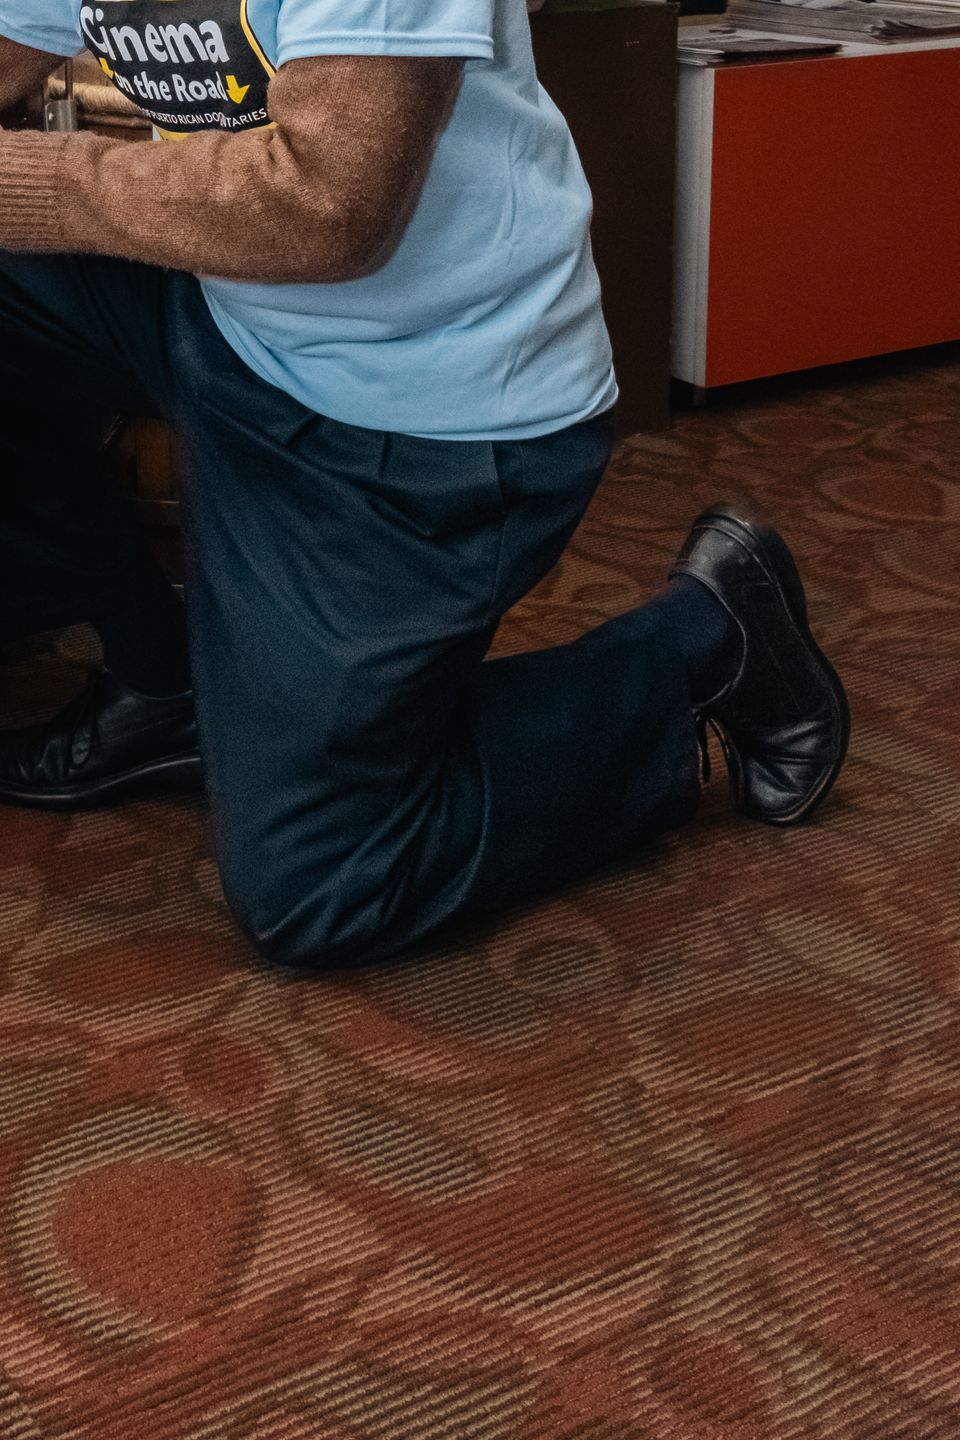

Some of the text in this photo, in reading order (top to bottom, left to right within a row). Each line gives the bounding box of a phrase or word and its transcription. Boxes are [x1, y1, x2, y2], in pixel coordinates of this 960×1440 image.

[80, 6, 230, 64] Cinema
[115, 71, 228, 103] on the Road
[150, 110, 178, 124] PUERTO
[178, 114, 205, 125] RICAN
